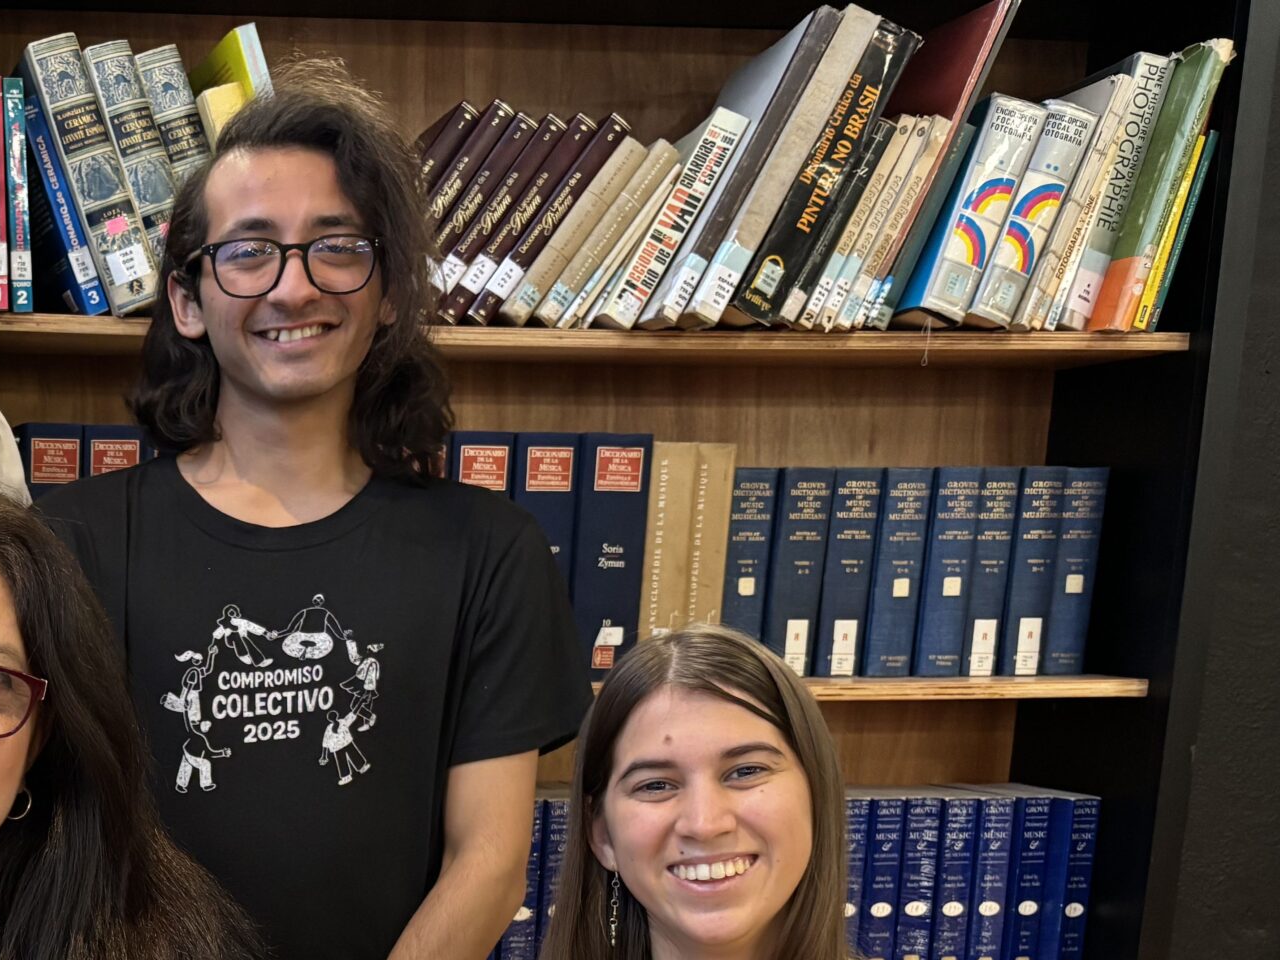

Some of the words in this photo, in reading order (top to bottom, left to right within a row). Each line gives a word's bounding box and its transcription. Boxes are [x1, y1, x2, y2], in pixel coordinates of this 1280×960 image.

[491, 118, 500, 127] 2
[1138, 91, 1160, 143] HISTOIRE
[832, 139, 852, 164] NO
[844, 84, 880, 141] BRASIL
[513, 131, 522, 139] 3
[543, 132, 550, 141] 5
[607, 132, 615, 141] 6
[1096, 62, 1160, 231] PHOTOGRAPHIE
[542, 196, 574, 237] Pintura
[519, 224, 544, 254] Diccionario
[16, 291, 28, 304] 2
[87, 291, 100, 304] 3
[35, 440, 76, 449] DICCIONARIO
[845, 500, 871, 508] MUSIC
[602, 543, 624, 554] Soria
[218, 664, 323, 690] COMPROMISO
[211, 686, 334, 720] COLECTIVO
[243, 720, 301, 743] 2025
[877, 806, 902, 815] GROVE
[875, 831, 899, 840] MUSIC
